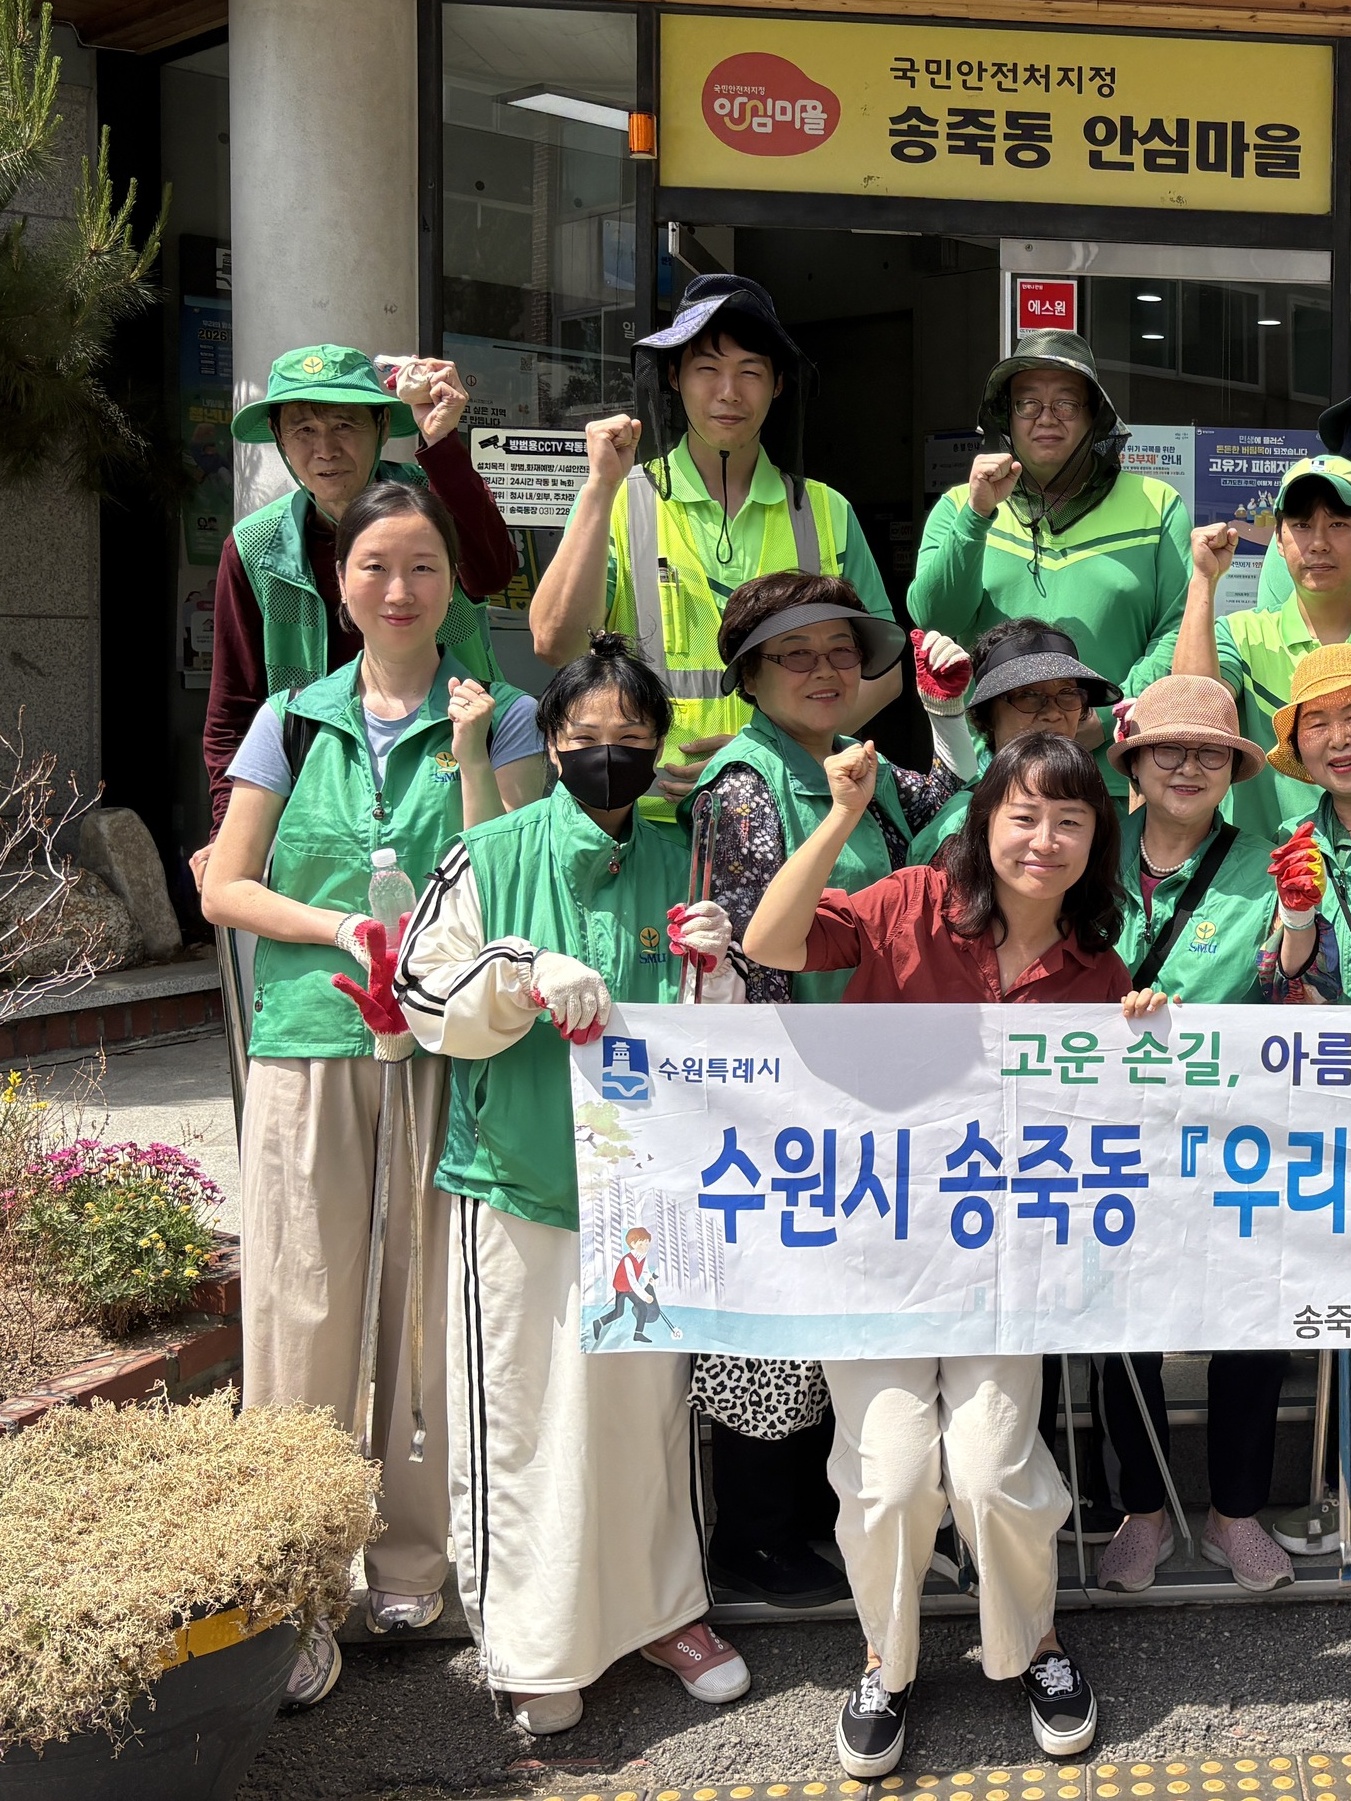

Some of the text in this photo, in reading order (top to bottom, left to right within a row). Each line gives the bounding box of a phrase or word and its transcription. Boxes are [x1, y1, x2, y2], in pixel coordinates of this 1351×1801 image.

[889, 56, 1116, 99] 국민안전처지정
[713, 84, 766, 96] 국민안전처지정
[713, 96, 828, 135] 안심마을
[888, 105, 1302, 180] 송죽동 안심마을
[1027, 300, 1066, 316] 에스원
[199, 330, 228, 341] 2026
[491, 408, 507, 417] 지역
[509, 439, 563, 452] 방범용CCTV
[1162, 446, 1176, 454] 위한
[1161, 454, 1182, 466] 안내
[1208, 459, 1248, 473] 고유가
[477, 462, 506, 471] 설치목적
[510, 478, 535, 486] 24시간
[535, 479, 550, 487] 작동
[553, 493, 576, 502] 주차장
[509, 506, 538, 515] 송죽동장
[1189, 941, 1218, 954] SMU
[639, 952, 666, 963] SMU
[1000, 1031, 1105, 1085] 고운
[1122, 1031, 1240, 1088] 손길,
[658, 1057, 780, 1083] 수원특례시
[698, 1126, 909, 1249] 수원시
[939, 1120, 1149, 1250] 송죽동
